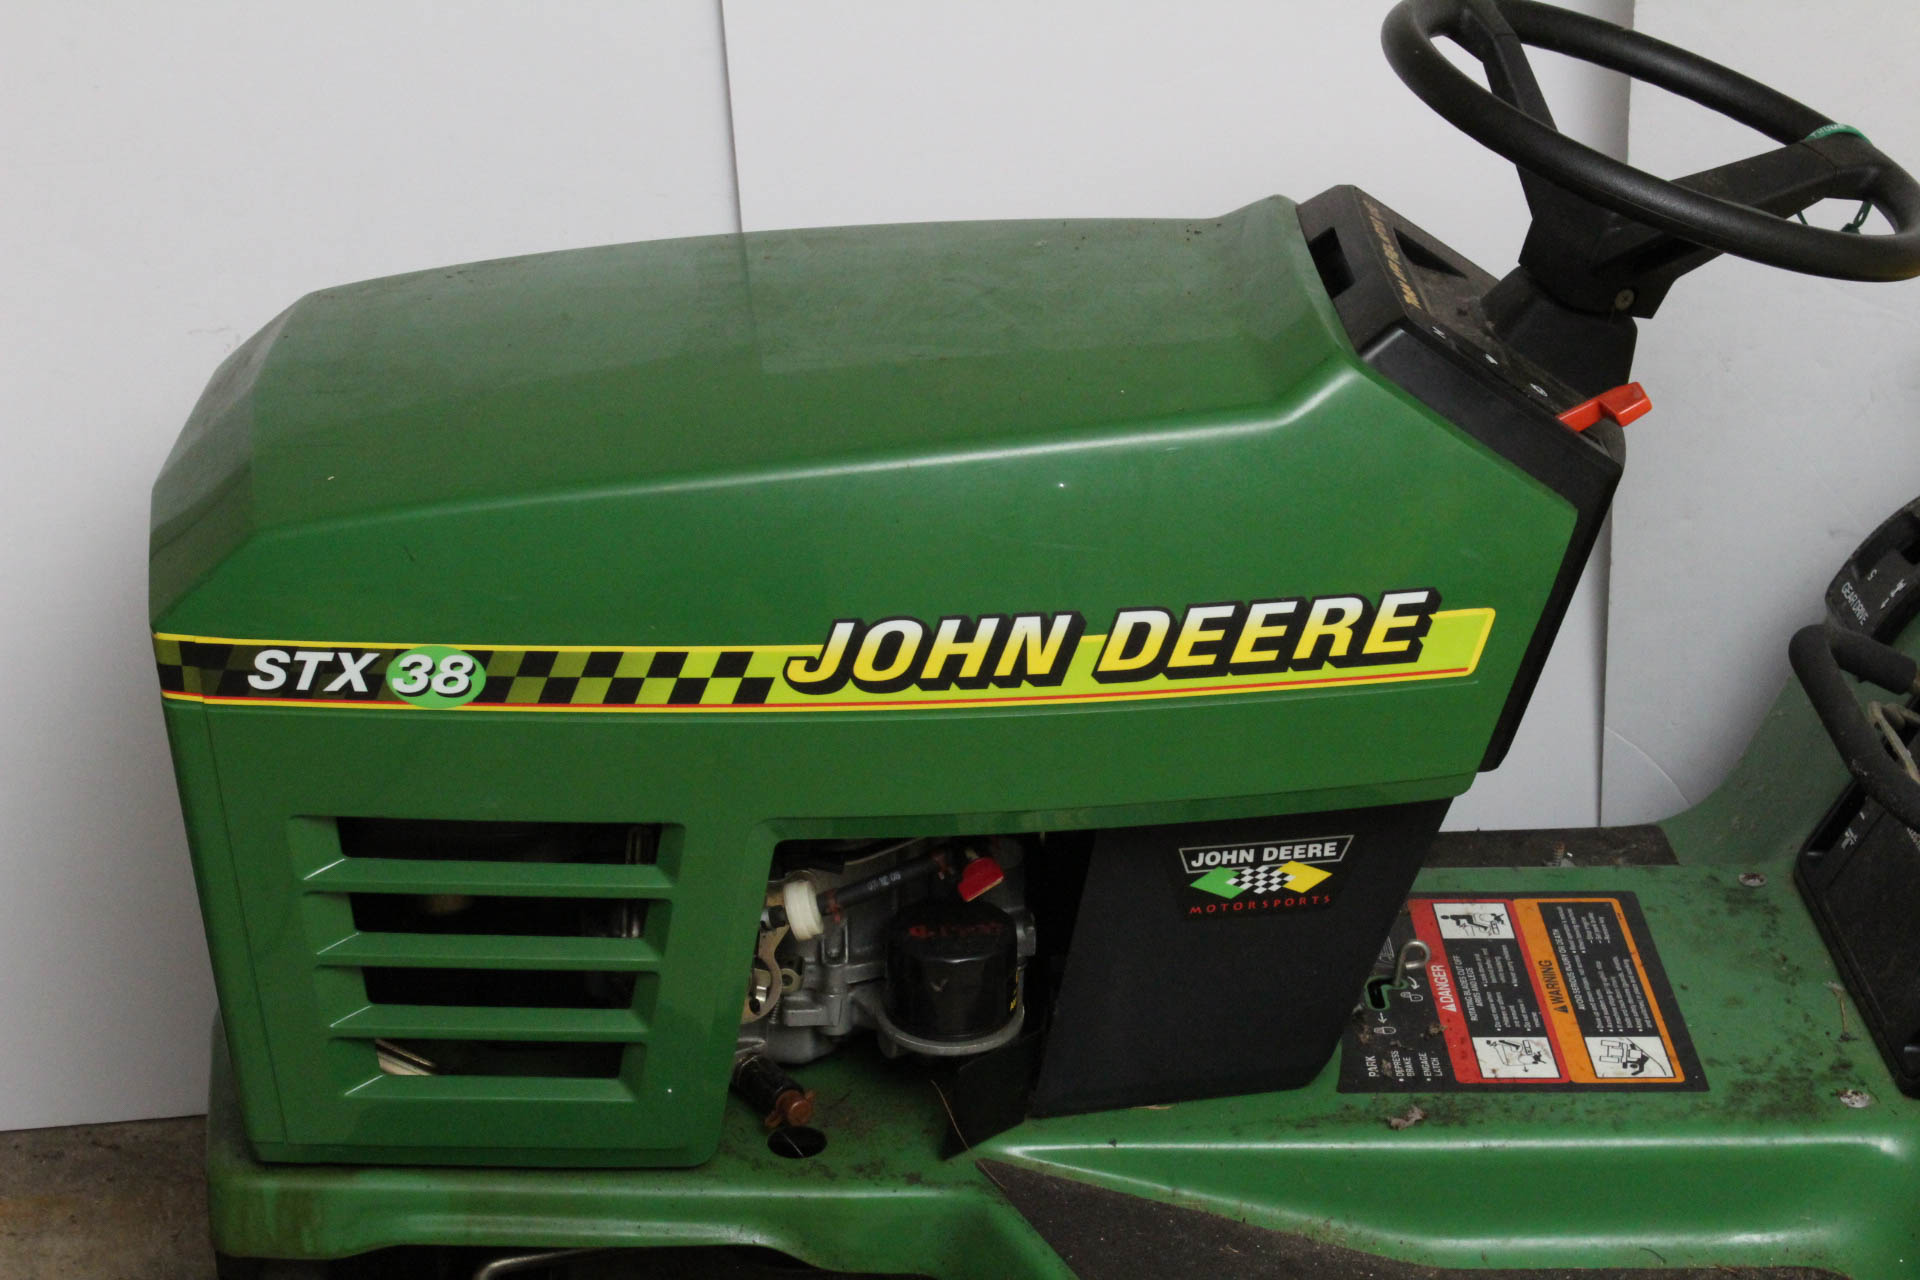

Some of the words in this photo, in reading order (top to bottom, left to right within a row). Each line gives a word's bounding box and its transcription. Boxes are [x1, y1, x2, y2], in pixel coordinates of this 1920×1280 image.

[1841, 582, 1858, 605] GEAR
[784, 613, 1084, 694] JOHN
[1093, 589, 1440, 686] DEERE
[247, 649, 380, 694] STX
[391, 653, 475, 698] 38
[1191, 848, 1254, 867] JOHN
[1263, 842, 1337, 861] DEERE
[1189, 895, 1331, 914] MOTORSPORTS
[1431, 964, 1454, 1003] DANGER
[1537, 960, 1565, 1003] WARNING
[1365, 1055, 1379, 1077] PARK
[1391, 1050, 1405, 1077] DEPRESS
[1403, 1057, 1415, 1077] BRAKE
[1419, 1052, 1432, 1077] ENGAGE
[1430, 1057, 1443, 1077] LATCH
